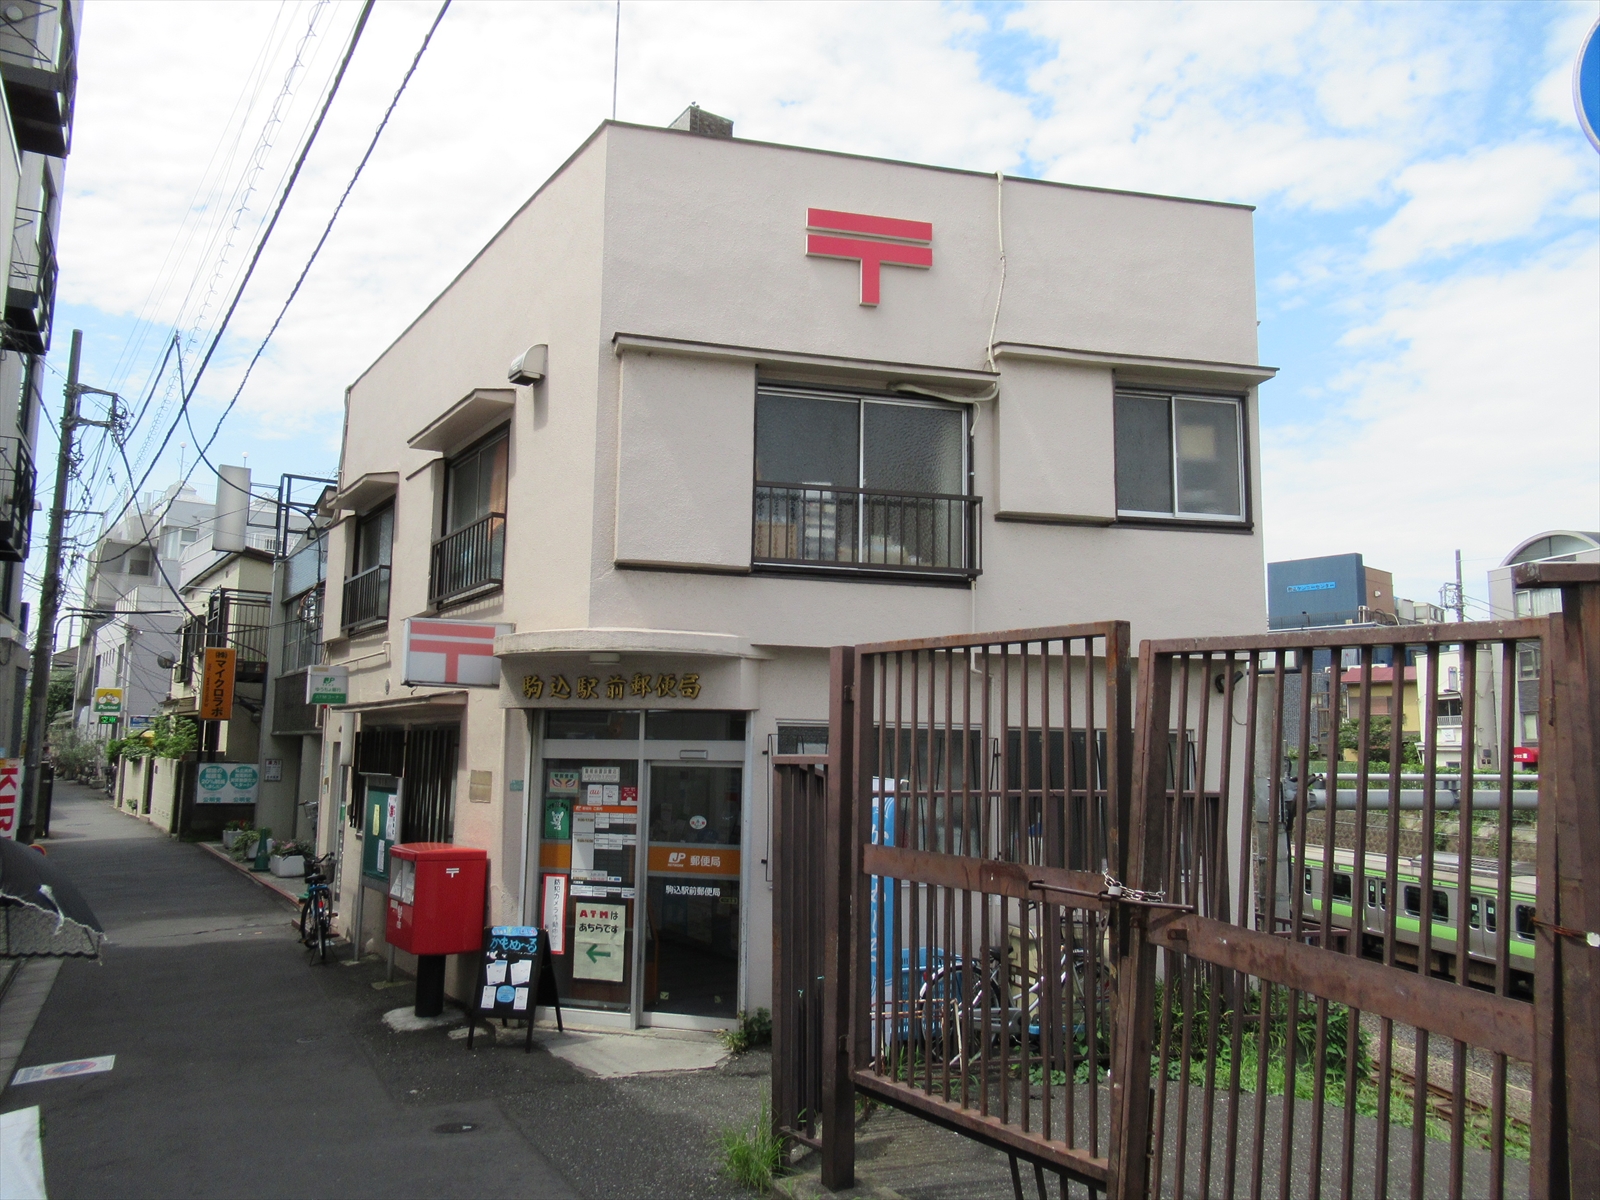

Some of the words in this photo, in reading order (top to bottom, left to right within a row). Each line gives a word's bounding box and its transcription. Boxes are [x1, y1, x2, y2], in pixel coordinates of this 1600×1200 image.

[522, 673, 701, 699] 駒込駅前郵便局
[0, 768, 18, 840] KIR
[690, 855, 720, 867] 郵便局
[665, 885, 720, 897] 駒込駅前郵便局
[579, 923, 619, 934] あちらです
